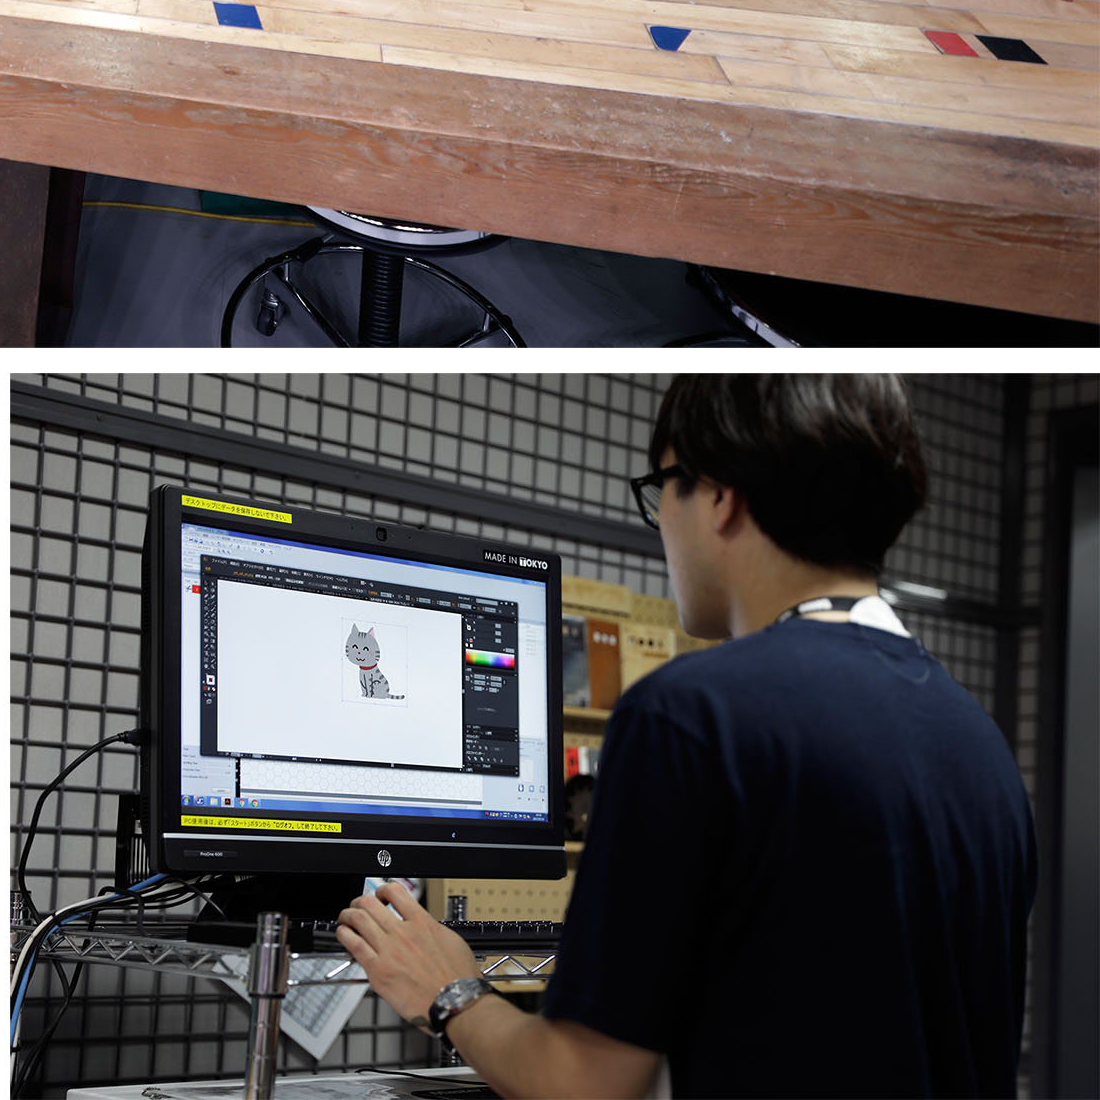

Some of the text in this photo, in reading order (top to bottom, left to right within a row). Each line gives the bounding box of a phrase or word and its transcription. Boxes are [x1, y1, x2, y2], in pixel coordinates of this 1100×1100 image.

[484, 551, 548, 570] MADE IN TOKYO
